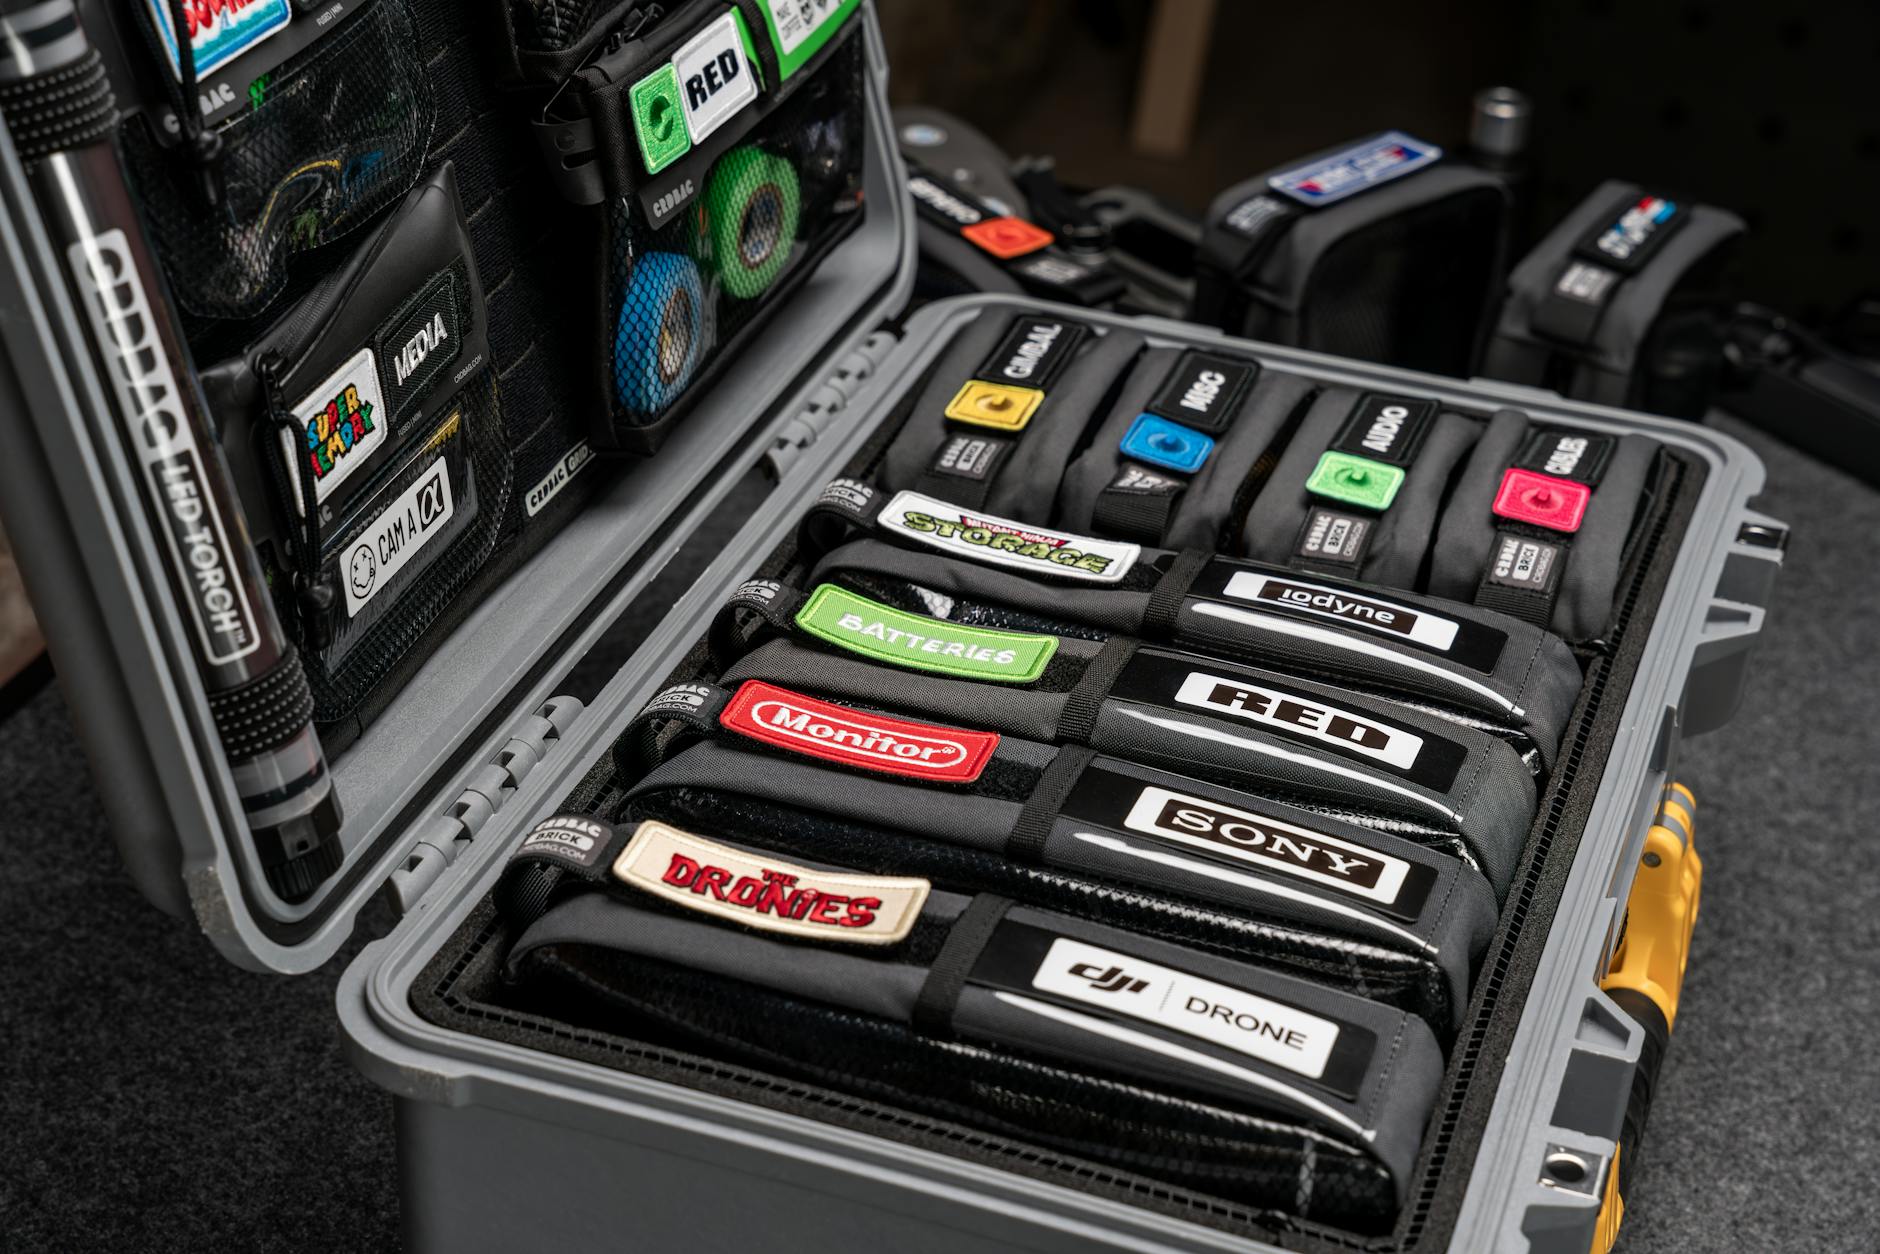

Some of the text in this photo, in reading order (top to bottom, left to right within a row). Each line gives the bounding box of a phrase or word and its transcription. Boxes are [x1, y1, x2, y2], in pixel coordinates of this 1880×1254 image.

[685, 48, 740, 112] RED
[393, 312, 448, 387] MEDIA
[307, 383, 361, 451] SUPER
[1180, 370, 1226, 412] MISC
[1361, 405, 1409, 453] AUDIO
[161, 464, 204, 524] LED
[378, 516, 405, 566] CAM
[407, 507, 417, 540] A
[903, 511, 1114, 575] STORAGE
[836, 612, 1017, 665] BATTERIES
[1206, 683, 1391, 751] RED
[536, 831, 582, 844] BRICK
[1171, 806, 1369, 876] SONY
[761, 868, 800, 889] THE
[1184, 996, 1308, 1051] DRONE
